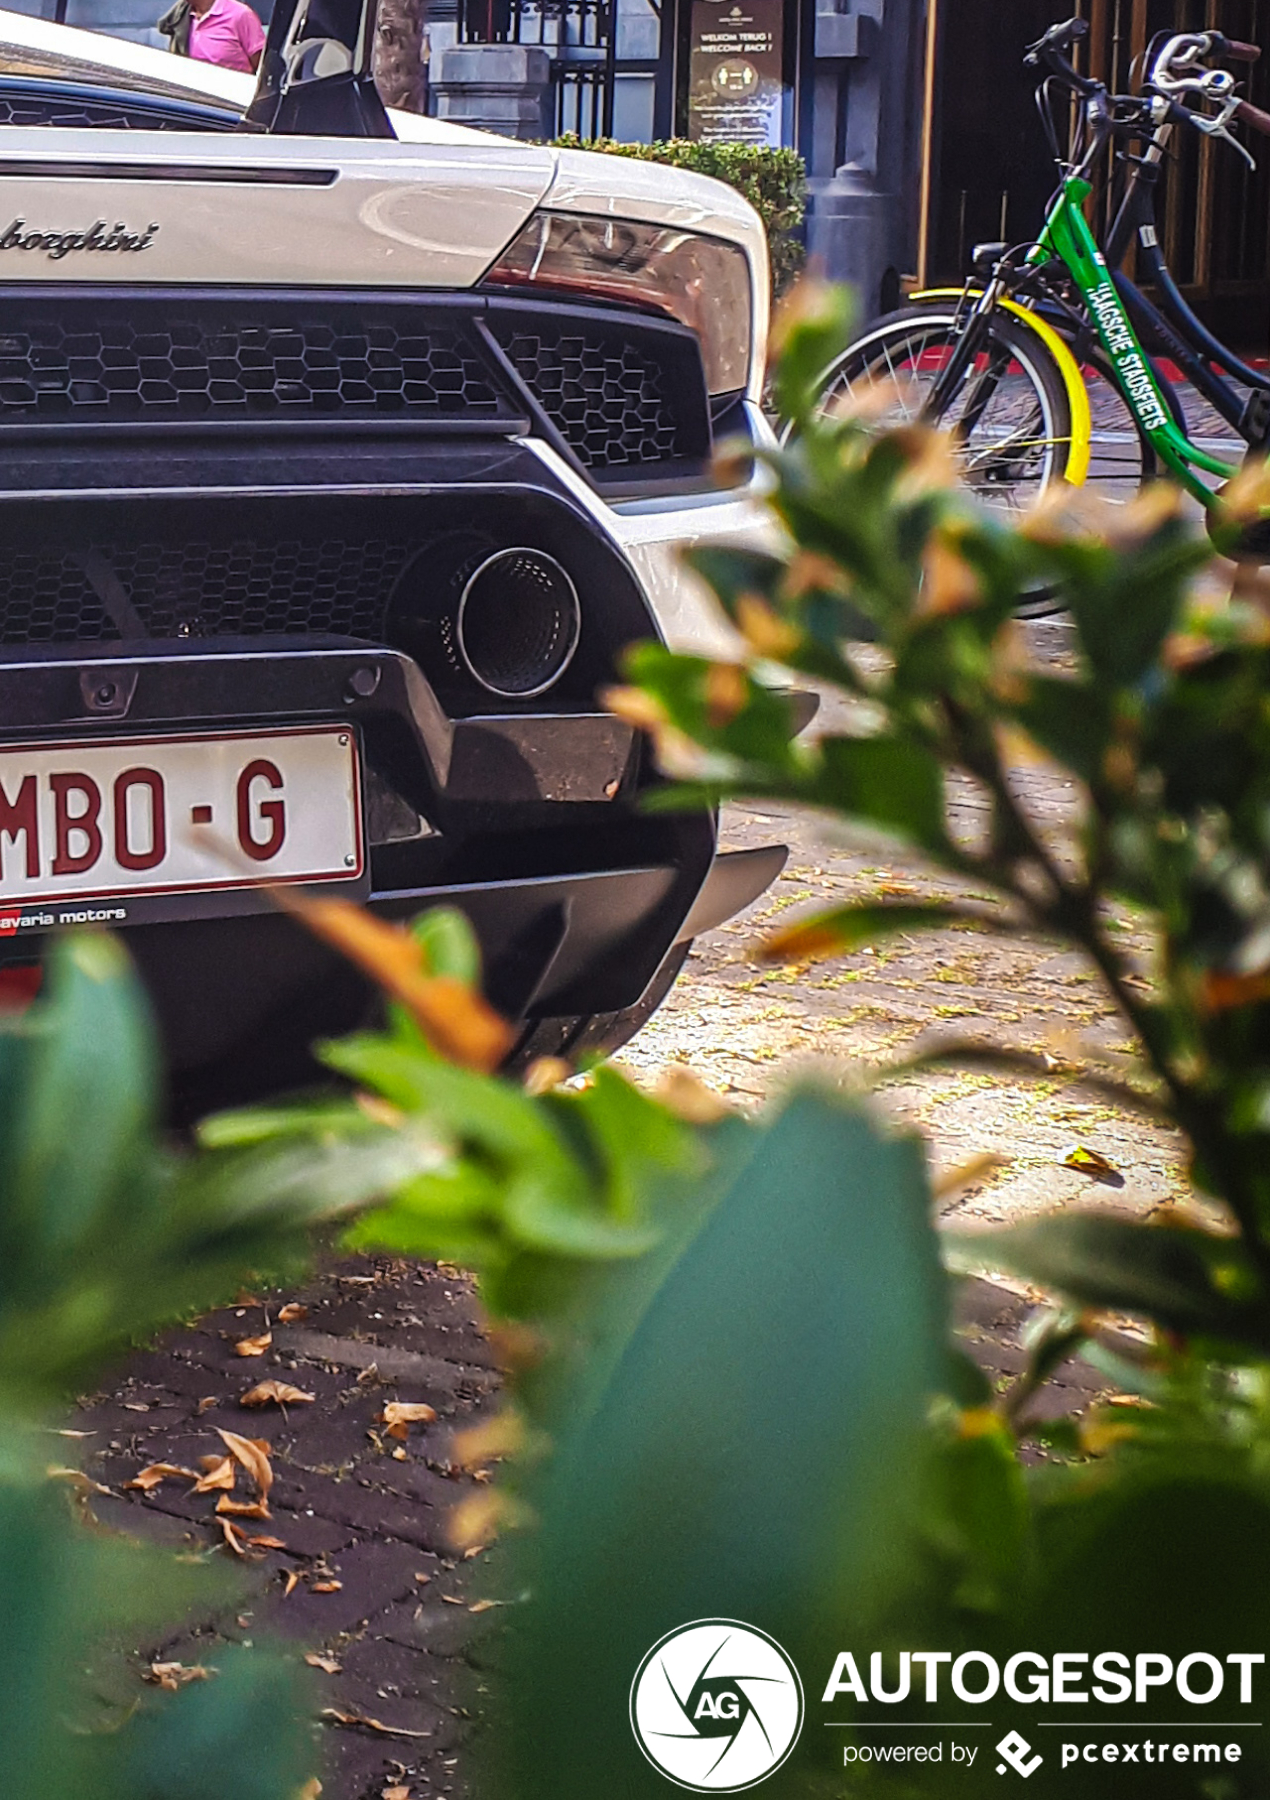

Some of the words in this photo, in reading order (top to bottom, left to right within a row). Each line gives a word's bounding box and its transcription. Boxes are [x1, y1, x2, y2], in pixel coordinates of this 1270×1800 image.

[700, 32, 737, 42] WELKOM
[739, 32, 766, 42] TERUG
[700, 44, 742, 53] WELCOME
[744, 44, 766, 53] BACK
[1117, 353, 1168, 431] STADSFIETS
[59, 908, 127, 924] motors
